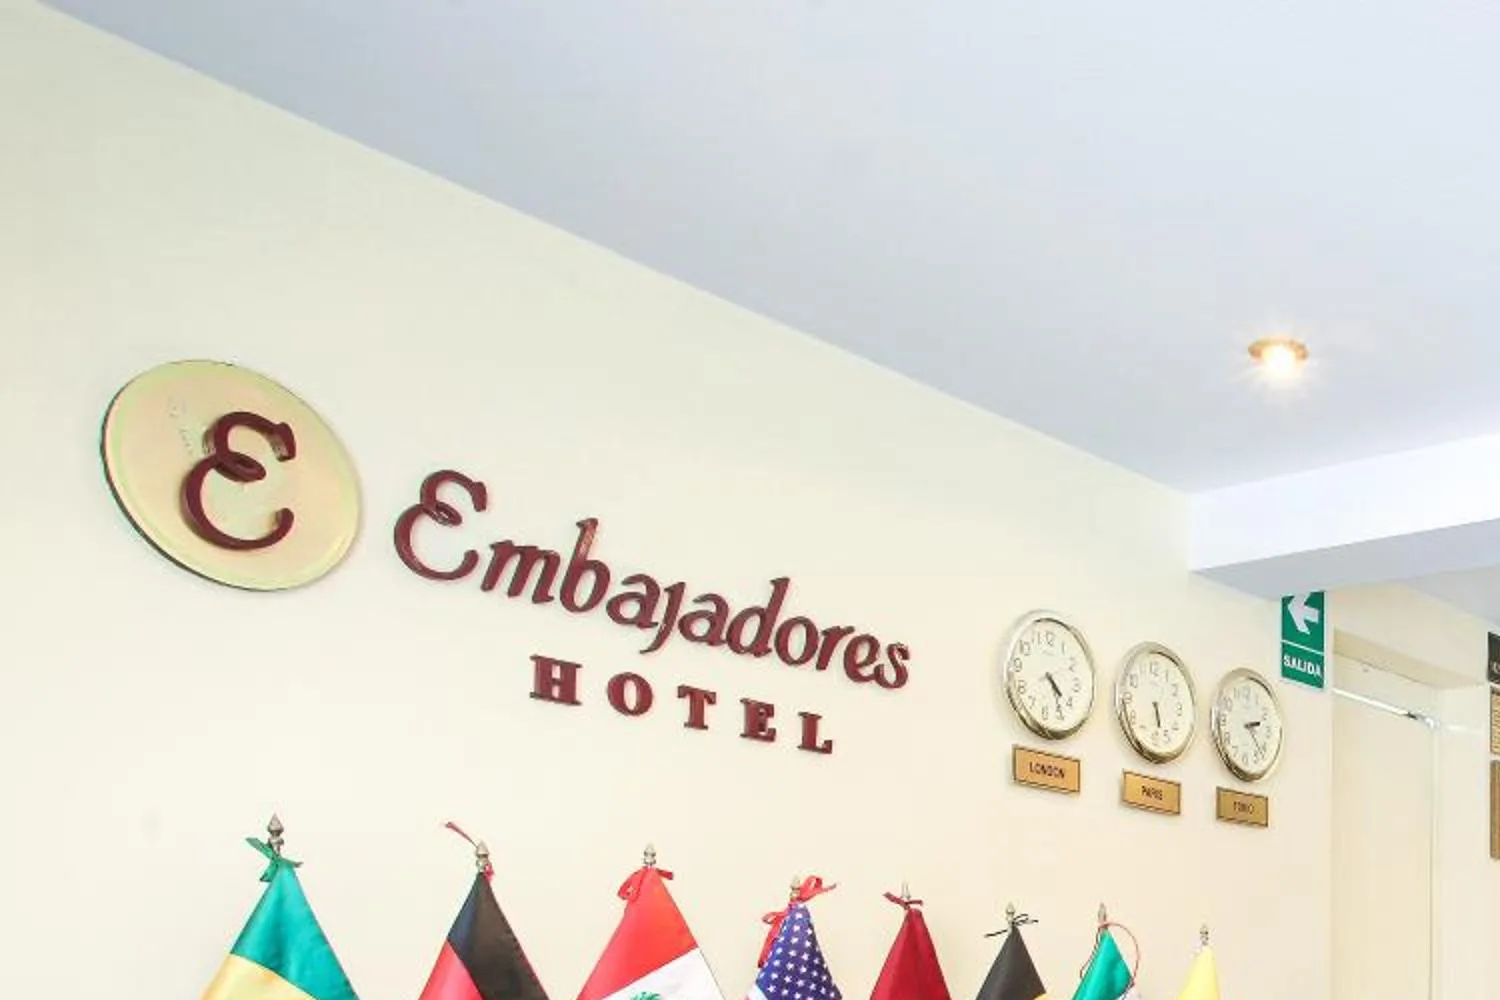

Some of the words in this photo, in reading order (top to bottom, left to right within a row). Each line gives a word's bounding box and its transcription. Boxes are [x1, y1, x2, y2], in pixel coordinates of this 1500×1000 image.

[394, 470, 910, 690] Embajadores
[1283, 654, 1322, 678] SALIDA
[529, 655, 834, 755] HOTEL
[1029, 761, 1065, 779] LONDON
[1141, 784, 1164, 801] PARIS
